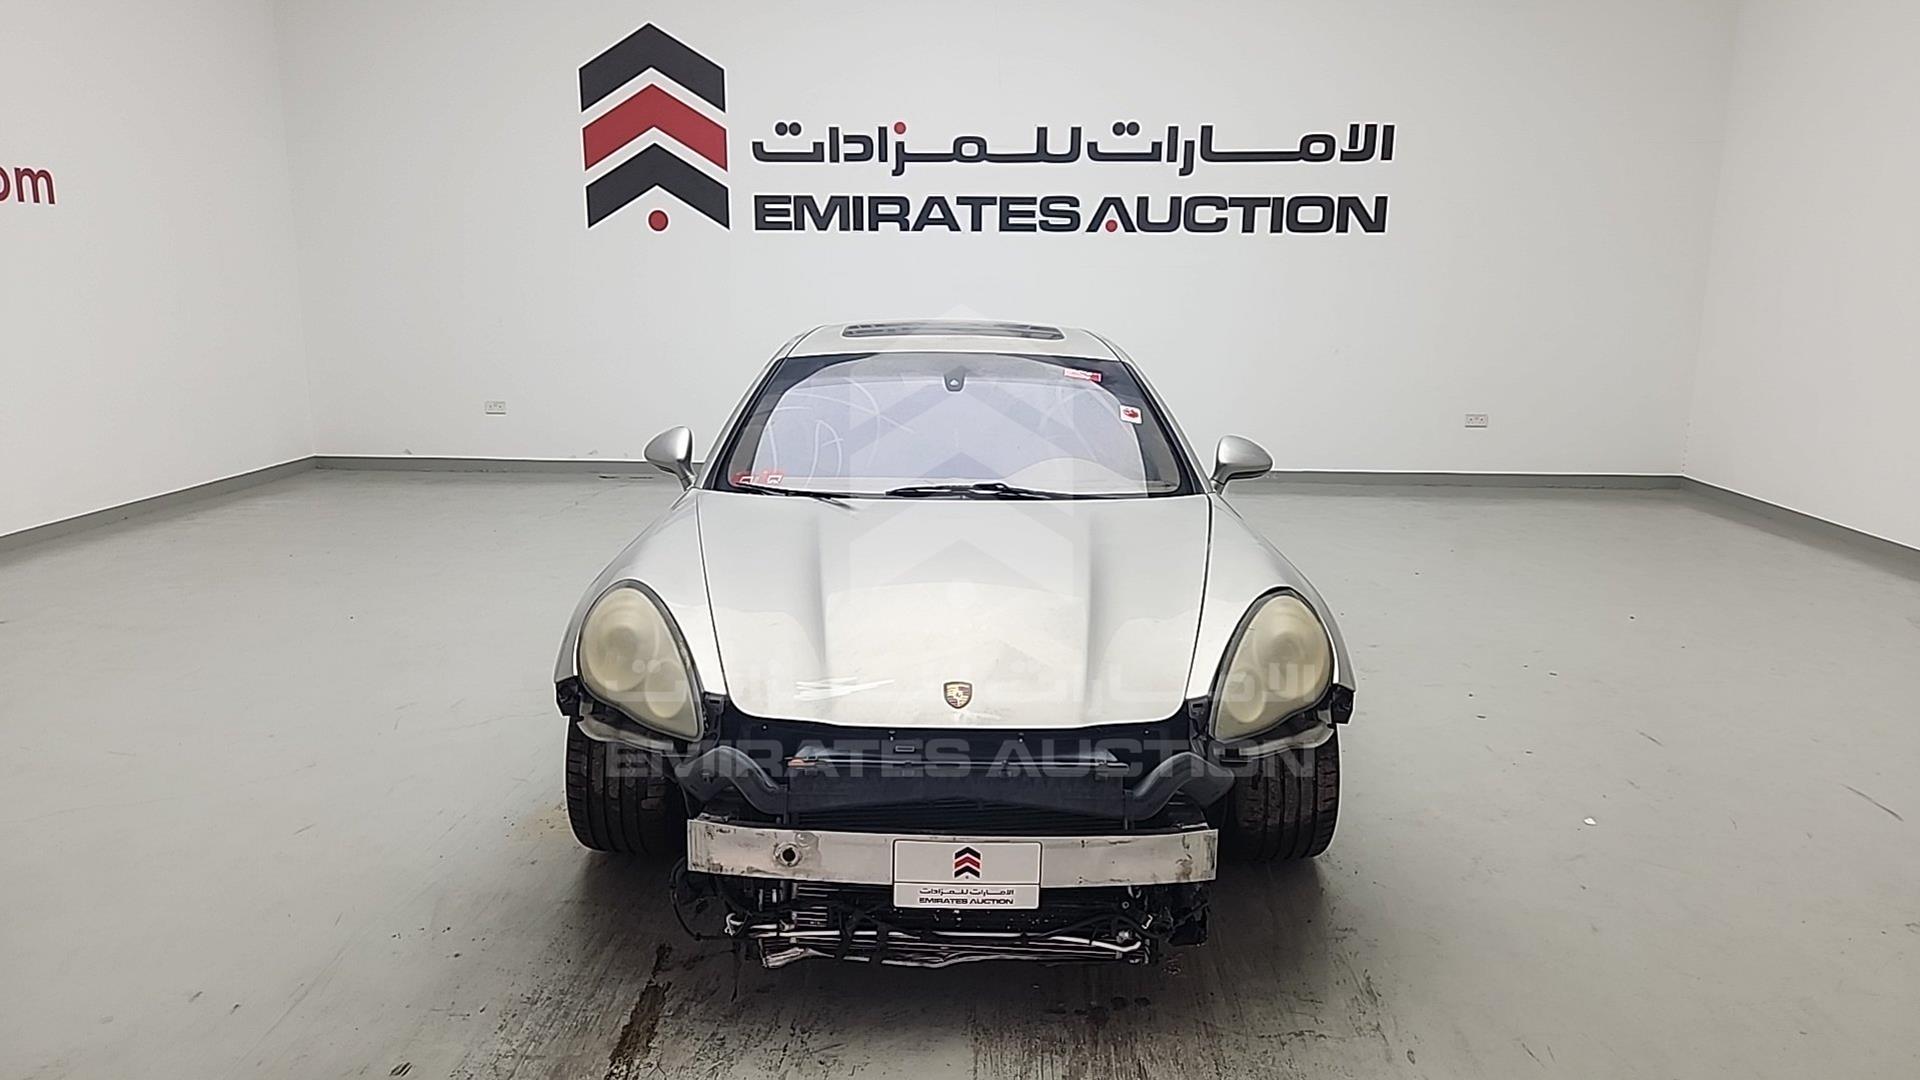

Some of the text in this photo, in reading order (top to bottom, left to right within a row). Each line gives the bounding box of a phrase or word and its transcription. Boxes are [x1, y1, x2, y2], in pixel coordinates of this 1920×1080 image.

[751, 121, 1082, 177] للمزادات
[754, 195, 1388, 233] EMIRATES AUCTION
